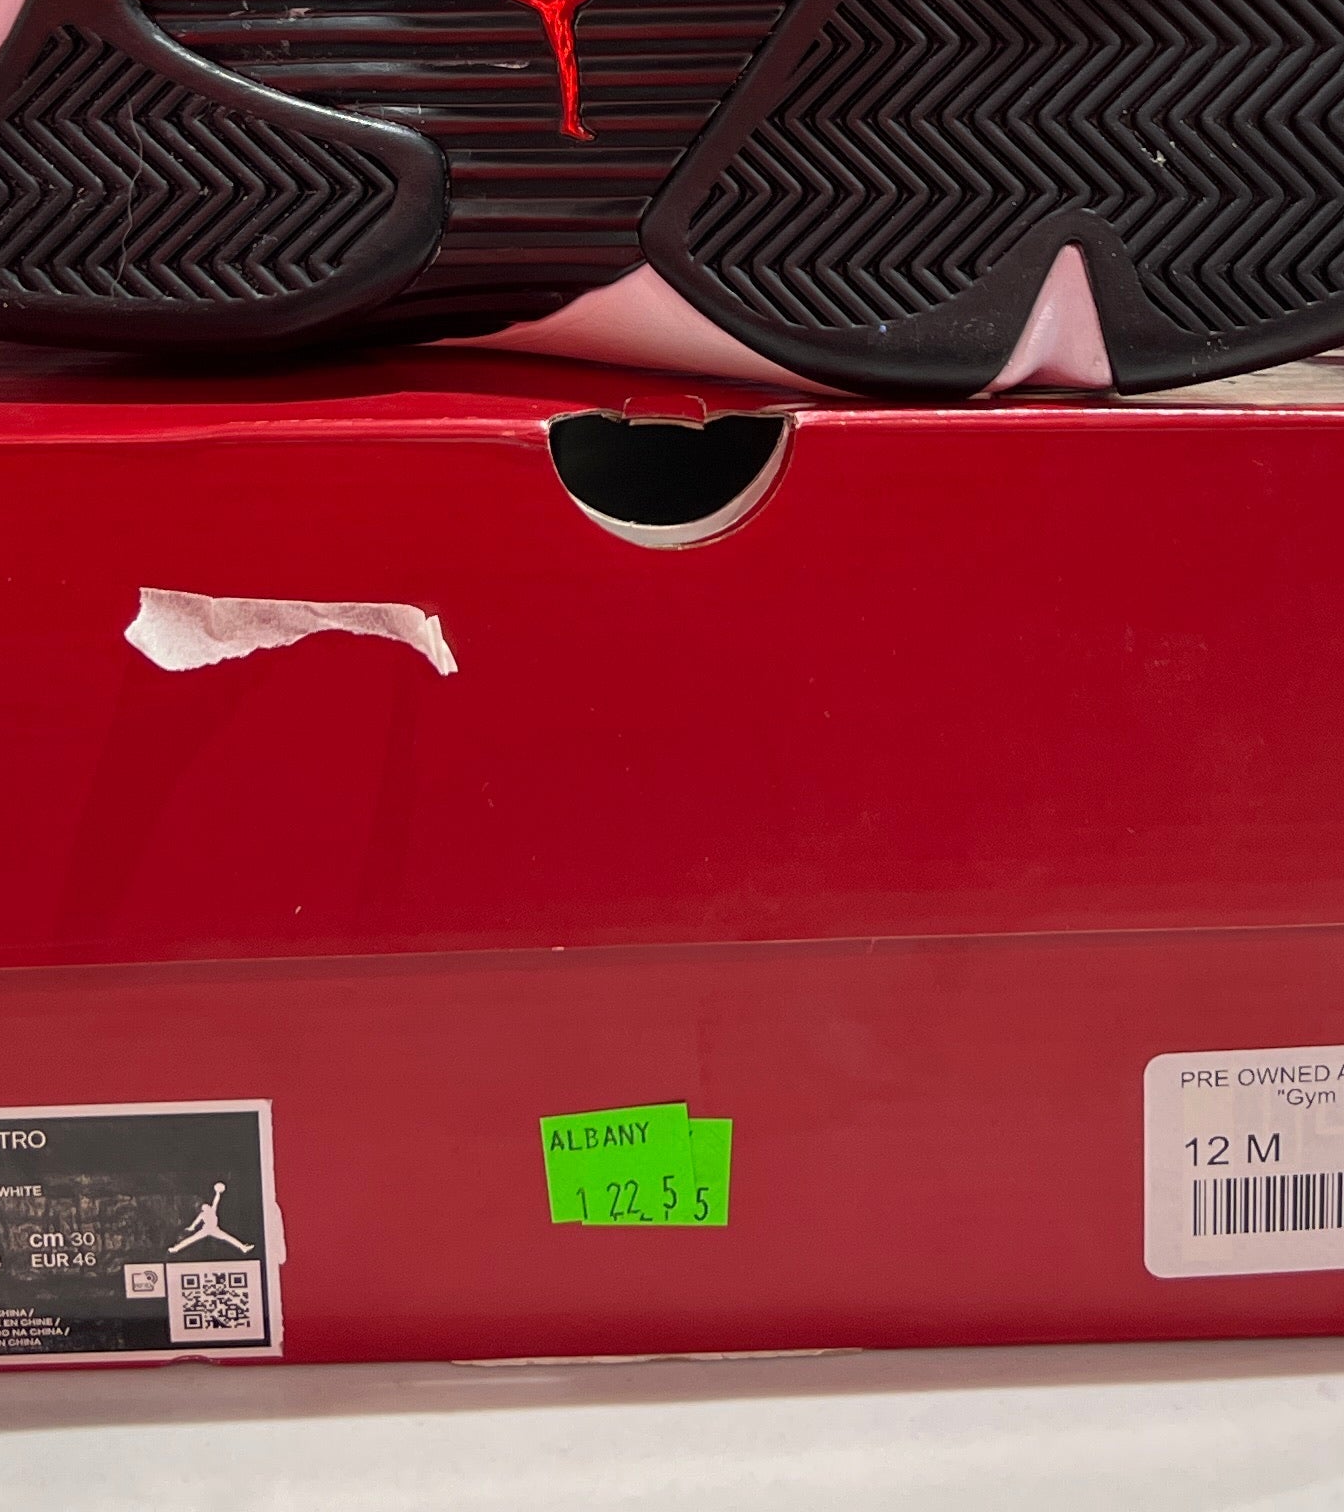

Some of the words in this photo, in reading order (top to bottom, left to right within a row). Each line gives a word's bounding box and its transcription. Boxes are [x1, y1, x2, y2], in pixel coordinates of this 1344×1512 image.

[1181, 1070, 1229, 1088] PRE
[1238, 1064, 1330, 1086] OWNED
[1278, 1089, 1336, 1109] "Gym
[550, 1121, 650, 1151] ALBANY
[1185, 1136, 1229, 1167] 12
[1247, 1133, 1280, 1164] M
[29, 1233, 64, 1248] cm
[71, 1232, 95, 1247] 30
[31, 1253, 69, 1268] EUR
[72, 1252, 96, 1267] 46
[4, 1319, 18, 1327] EN
[20, 1318, 53, 1326] CHINE
[12, 1328, 27, 1336] NA
[30, 1327, 63, 1336] CHINA
[8, 1338, 42, 1347] CHINA
